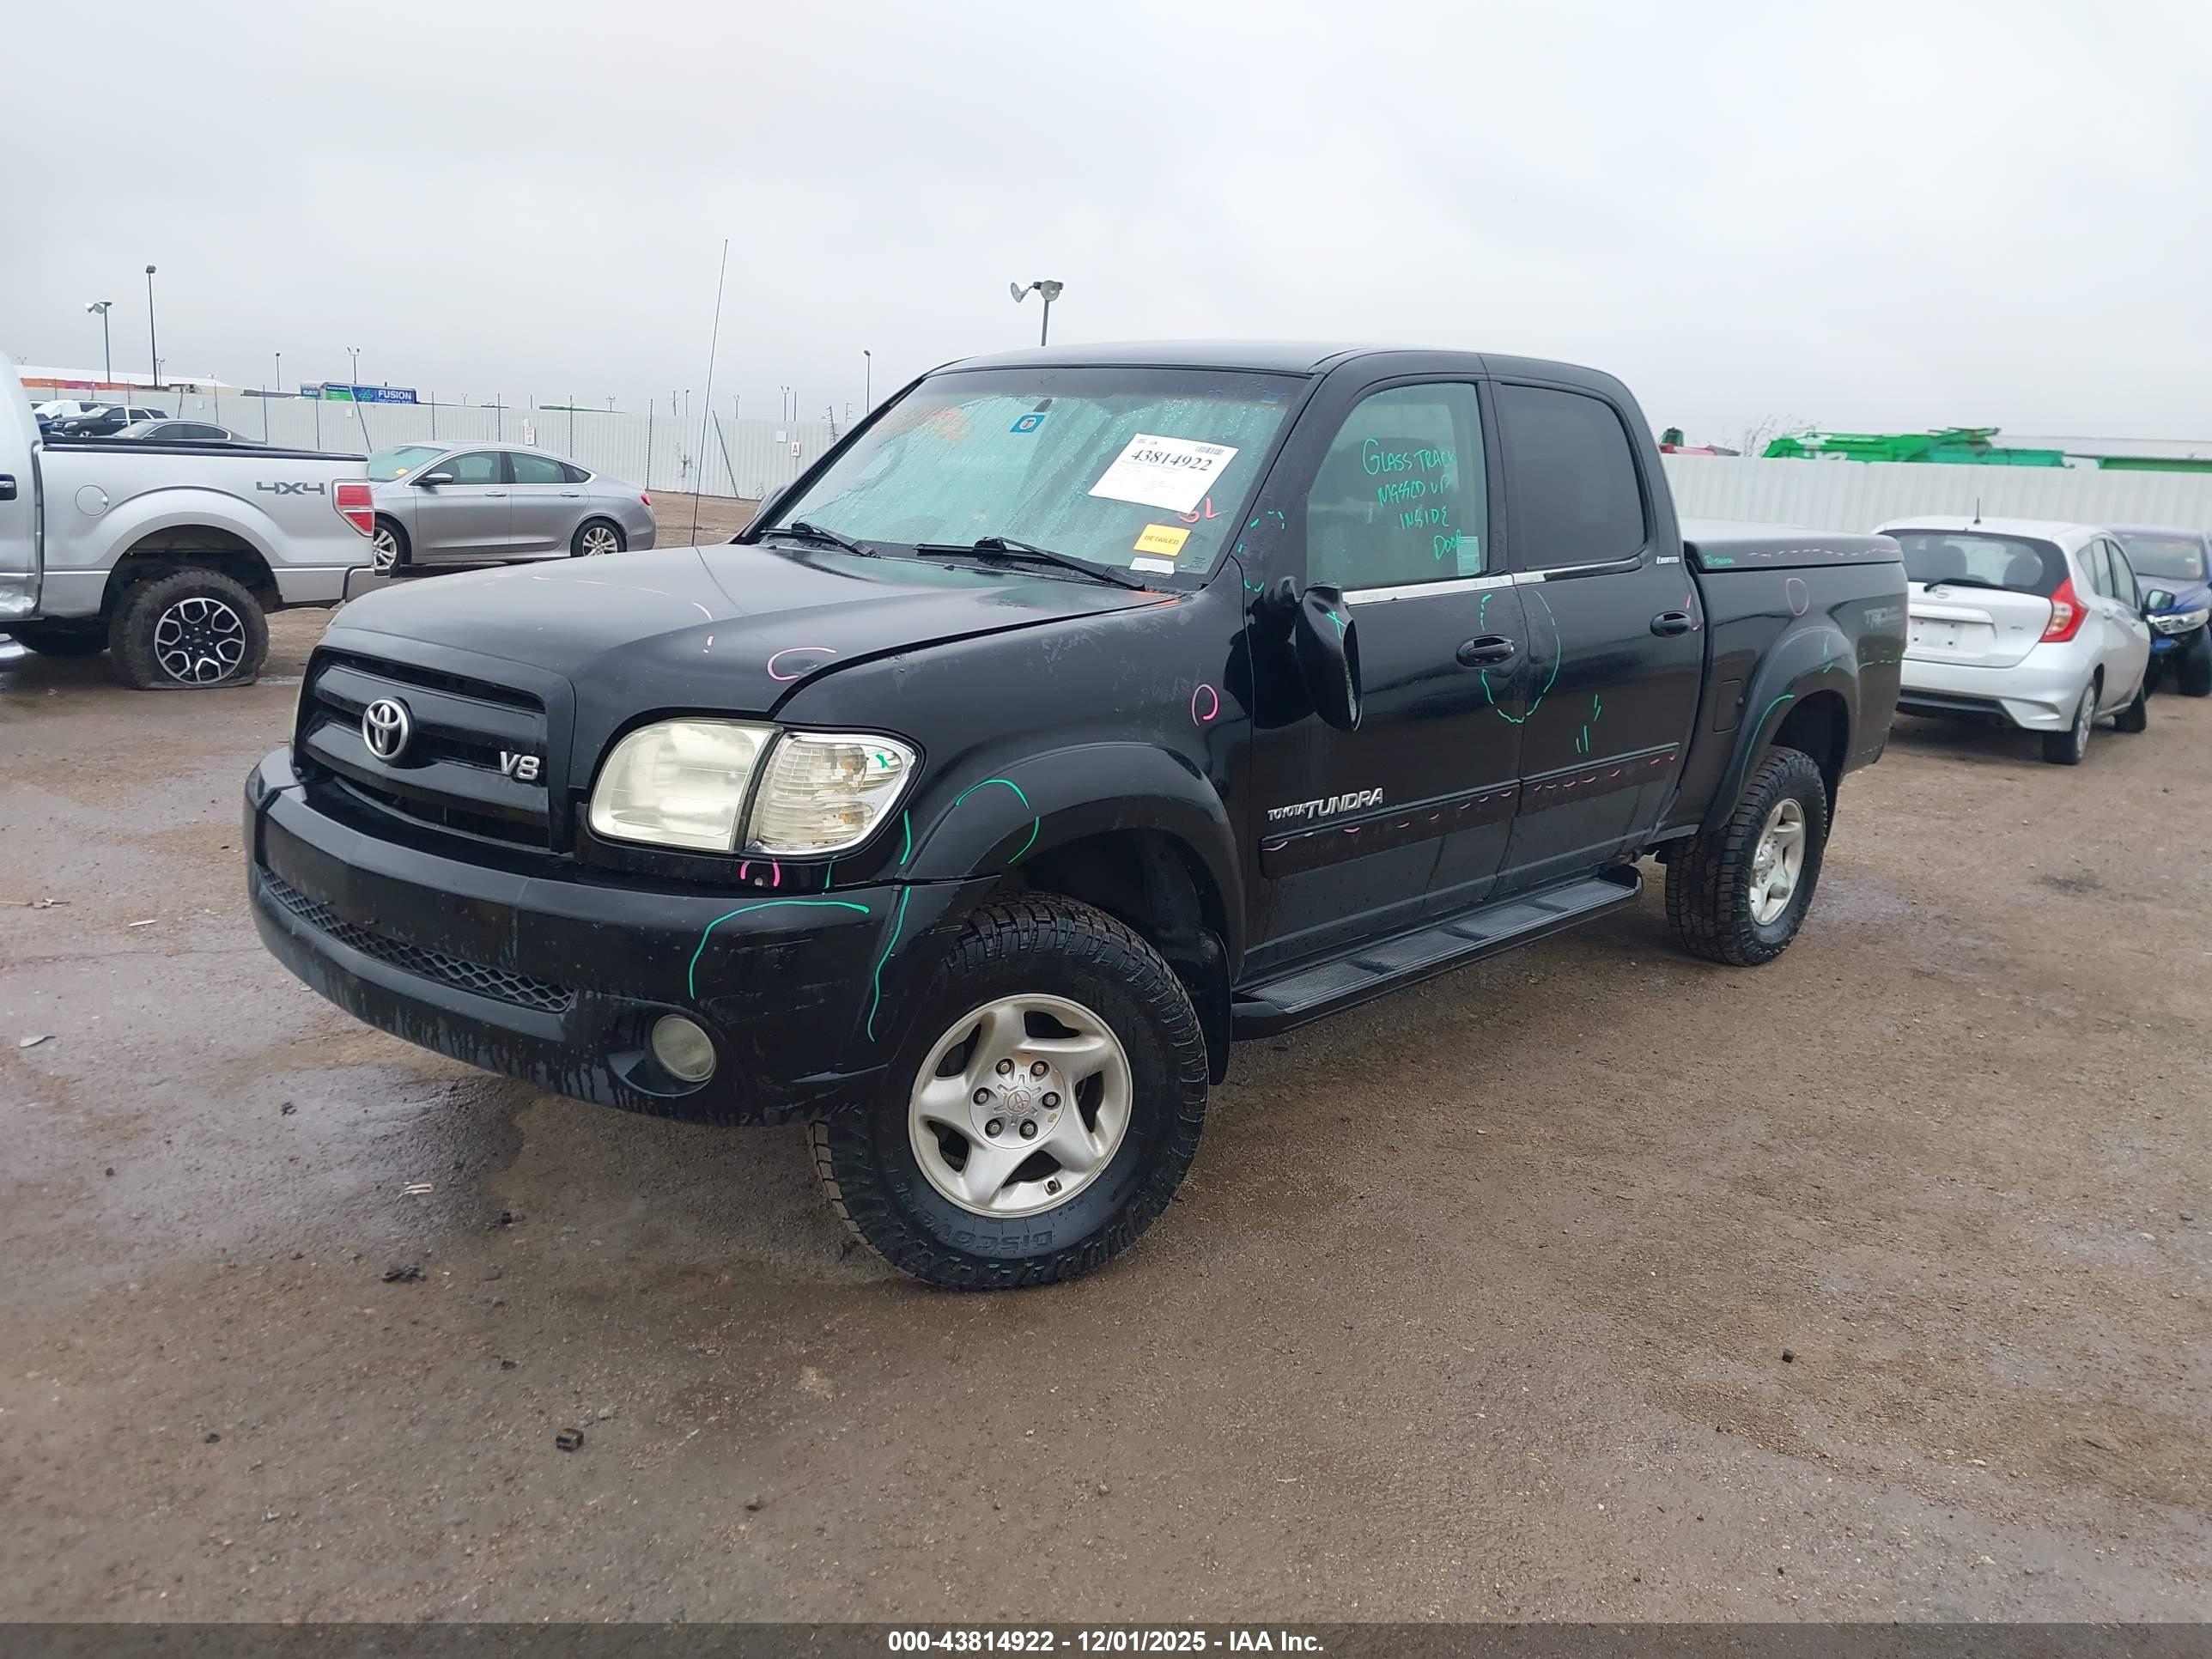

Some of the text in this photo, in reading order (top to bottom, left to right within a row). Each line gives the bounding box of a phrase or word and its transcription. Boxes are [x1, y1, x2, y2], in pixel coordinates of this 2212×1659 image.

[378, 389, 412, 400] FUSION
[792, 443, 799, 454] A
[1362, 438, 1413, 475] GLASS
[1131, 449, 1213, 471] 43814922
[1431, 474, 1450, 495] UP
[1400, 506, 1450, 530] INSIDE
[1144, 534, 1180, 546] DETAILED
[500, 750, 540, 781] V8
[1267, 787, 1383, 821] TOYOTA TUNDRA
